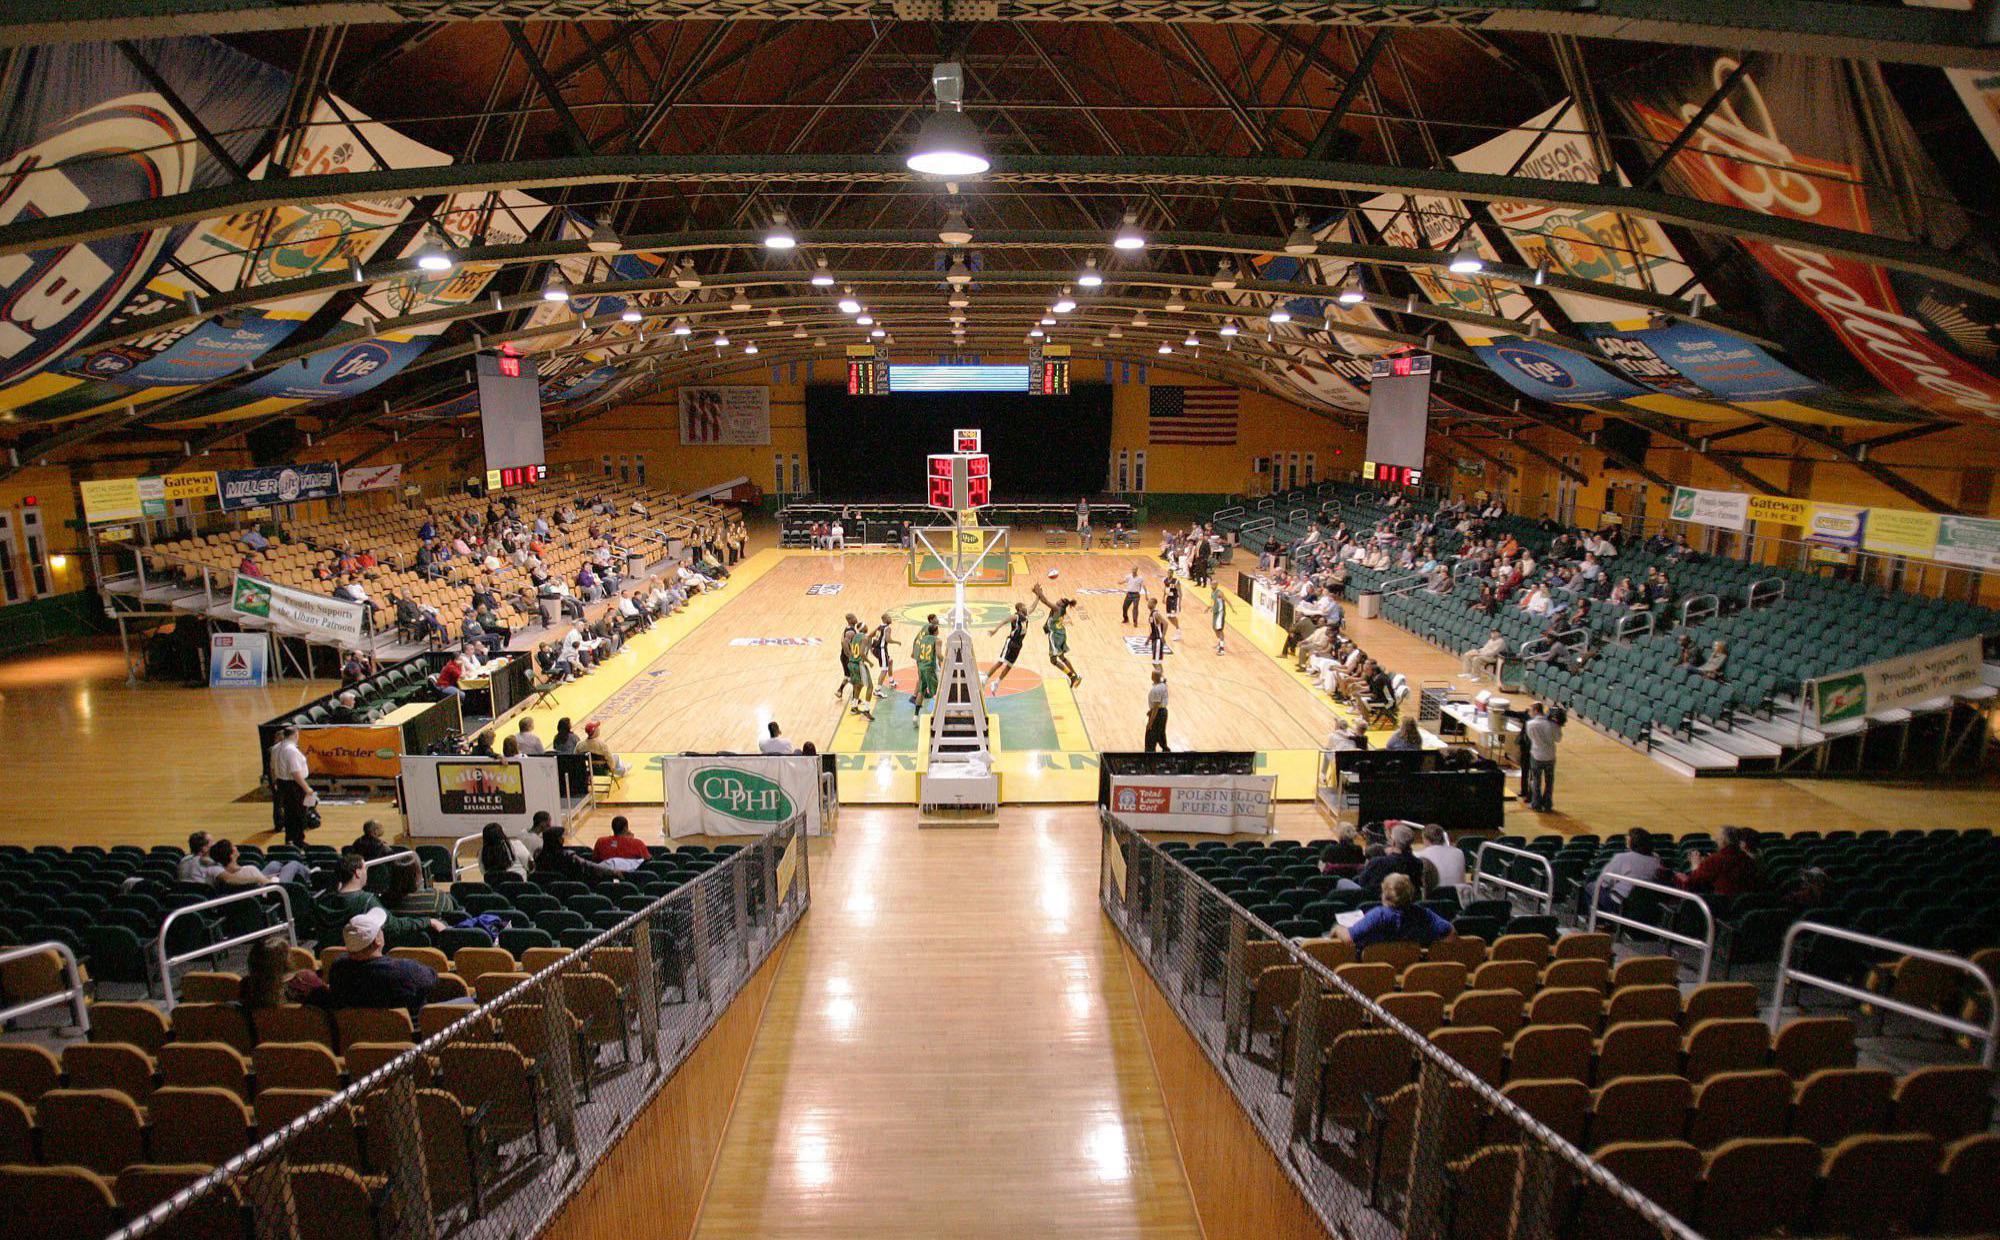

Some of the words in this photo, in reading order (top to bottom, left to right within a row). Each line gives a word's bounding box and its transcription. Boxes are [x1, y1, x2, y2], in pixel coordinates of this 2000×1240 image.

[164, 475, 213, 488] Gateway
[226, 479, 278, 498] MILLER
[173, 487, 209, 497] DINER
[932, 478, 952, 507] 24
[968, 478, 987, 507] 24
[1750, 497, 1806, 514] Gateway
[1755, 510, 1797, 522] DINER
[317, 604, 353, 620] Supports
[293, 612, 319, 627] Albany
[321, 616, 356, 633] Patroons
[463, 795, 502, 804] DINER
[1182, 801, 1228, 814] FUELS
